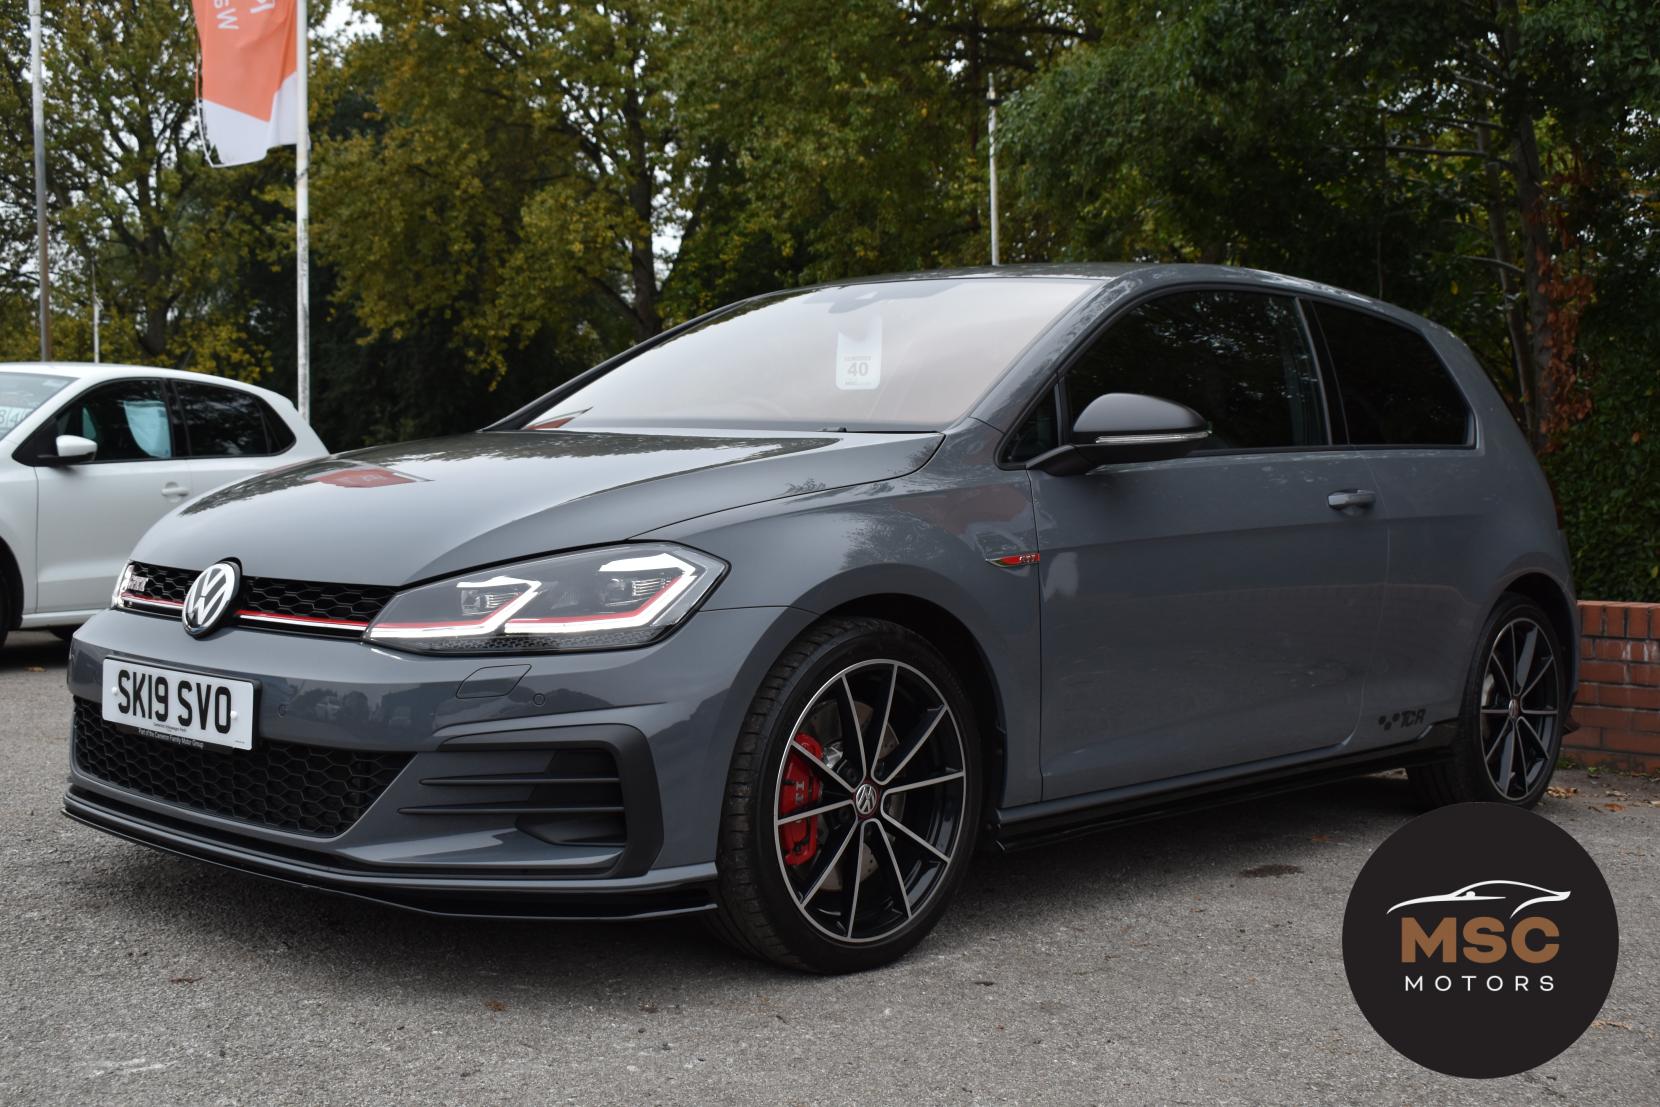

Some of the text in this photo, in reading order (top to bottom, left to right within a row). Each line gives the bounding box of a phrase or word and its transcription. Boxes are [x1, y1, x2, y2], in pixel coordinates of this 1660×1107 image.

[847, 361, 869, 377] 40
[118, 669, 232, 734] SK19 SVO
